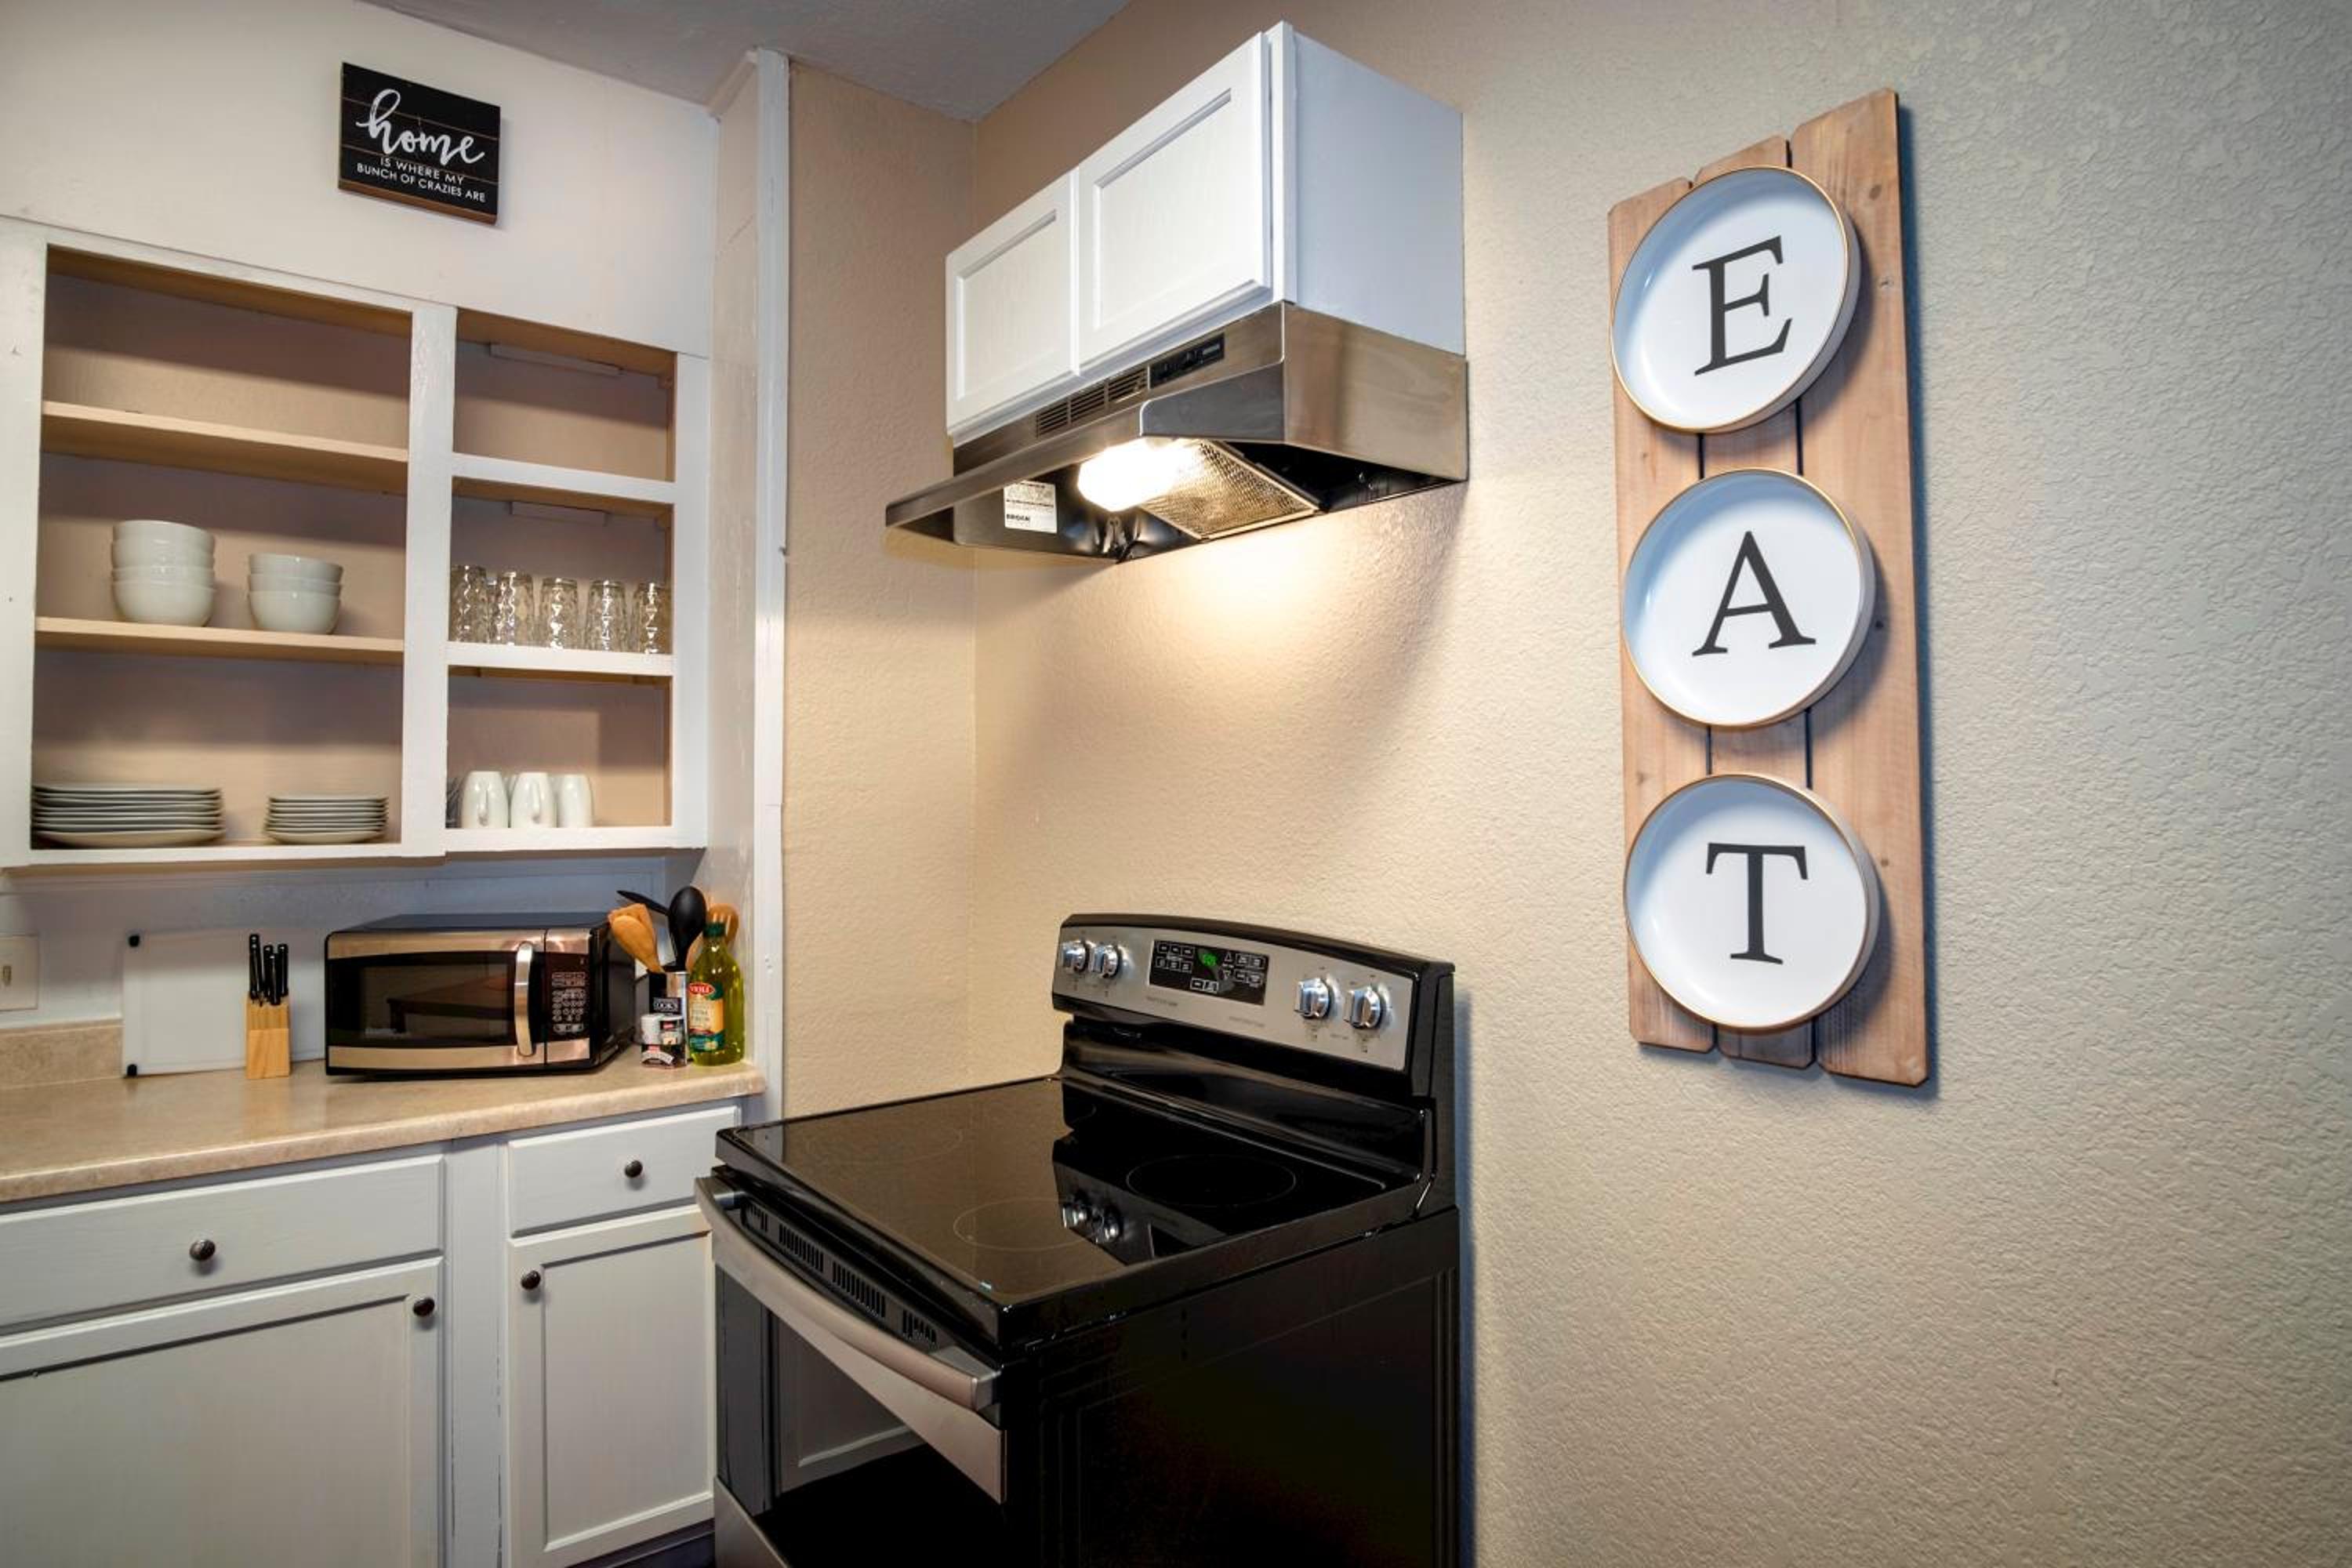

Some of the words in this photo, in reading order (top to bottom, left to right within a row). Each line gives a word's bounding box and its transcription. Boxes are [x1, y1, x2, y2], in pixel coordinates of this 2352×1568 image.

[355, 89, 485, 165] home
[357, 163, 397, 180] BUNCH
[401, 173, 416, 185] OF
[418, 179, 462, 197] CRAZIES
[465, 191, 486, 203] ARE
[380, 157, 391, 168] IS
[396, 161, 440, 180] WHERE
[445, 173, 464, 185] MY
